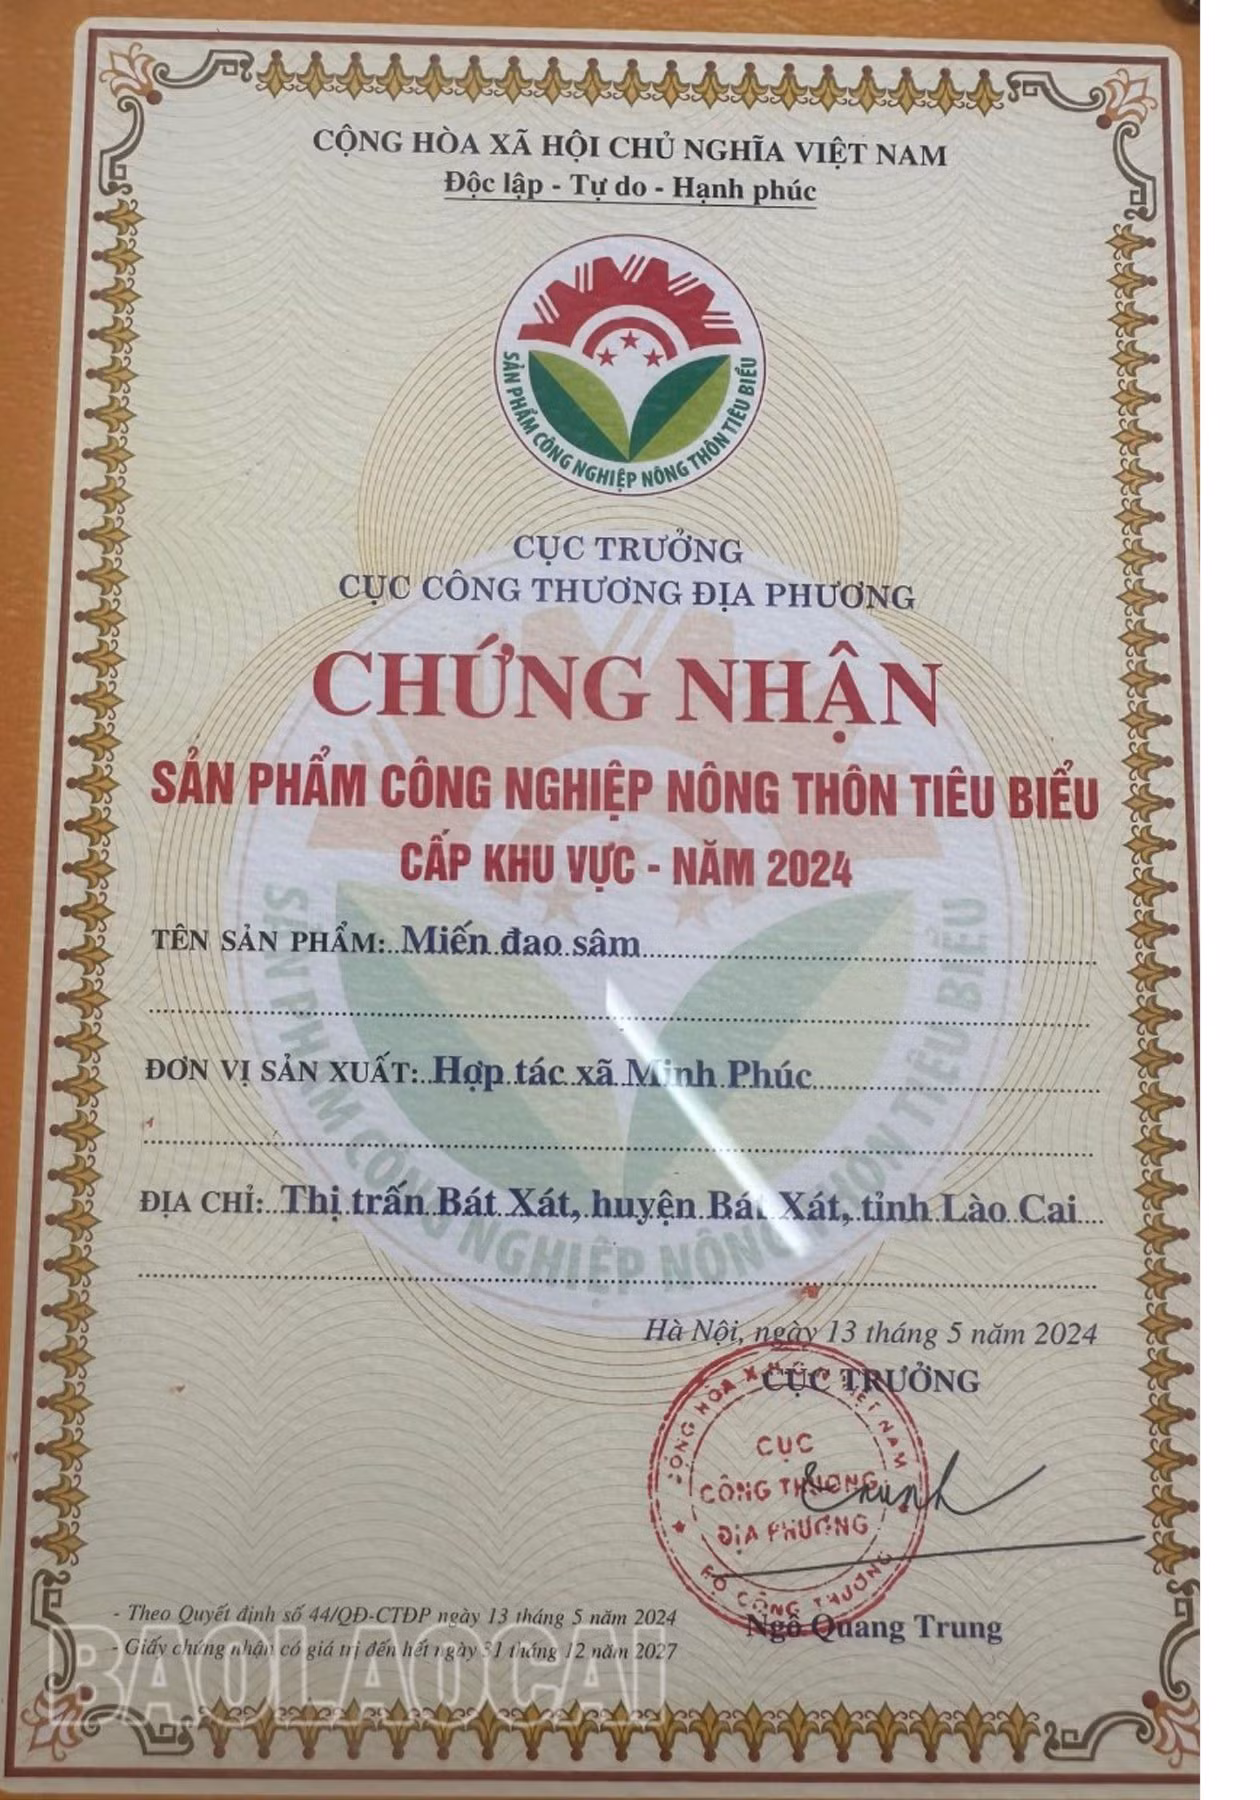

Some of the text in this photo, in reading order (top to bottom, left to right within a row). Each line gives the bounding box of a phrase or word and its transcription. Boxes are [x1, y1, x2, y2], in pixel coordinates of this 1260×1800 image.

[313, 124, 946, 169] CỘNG HÒA XÃ HỘI CHỦ NGHĨA VIỆT NAM
[444, 170, 817, 205] Độc lập Tự do Hạnh phúc
[502, 351, 757, 493] SẢN PHẨM CÔNG NGHIỆP NÔNG THÔN TIÊU BIỂU
[513, 528, 743, 567] CỤC TRƯỞNG
[339, 569, 915, 612] CỤC CÔNG THƯƠNG ĐỊA PHƯƠNG
[312, 633, 943, 742] CHỨNG NHẬN
[151, 745, 1098, 821] SẢN PHẨM CÔNG NGHIỆP NÔNG THÔN TIÊU BIỂU
[401, 828, 853, 893] CẤP KHU VỰC NĂM 2024
[152, 924, 208, 952] TÊN
[222, 923, 278, 953] SẢN
[402, 920, 489, 956] Miến
[500, 927, 563, 956] đao
[572, 929, 641, 957] sâm
[145, 1056, 208, 1081] ĐƠN
[221, 1059, 250, 1087] VỊ
[261, 1053, 318, 1083] SẢN
[434, 1055, 504, 1092] Hợp
[516, 1057, 565, 1087] tác
[577, 1059, 615, 1087] xã
[626, 1058, 715, 1088] Minh
[728, 1060, 812, 1089] Phúc
[140, 1190, 191, 1218] ĐỊA
[281, 1184, 341, 1222] Thị
[352, 1180, 424, 1216] trấn
[437, 1187, 501, 1217] Bát
[509, 1187, 584, 1223] Xát,
[592, 1189, 696, 1226] huyện
[861, 1191, 929, 1223] tỉnh
[944, 1194, 1006, 1223] Lào
[1019, 1195, 1076, 1223] Cai
[644, 1318, 1098, 1350] Hà Nội, ngày 13 tháng 5 năm 2024
[761, 1366, 830, 1398] CỤC
[841, 1361, 981, 1394] TRƯỞNG
[757, 1432, 814, 1462] CỤC
[700, 1473, 771, 1504] CÔNG
[127, 1603, 678, 1629] Theo Quyết định số 44/QĐ-CTĐP ngày 13 tháng 5 năm 2024
[747, 1613, 1002, 1645] Ngô Quang Trung
[125, 1636, 168, 1660] Giấy
[172, 1637, 225, 1660] chứng
[230, 1639, 275, 1660] nhận
[280, 1639, 303, 1657] có
[306, 1639, 340, 1661] giá
[344, 1641, 360, 1660] trị
[365, 1638, 398, 1658] đến
[402, 1639, 429, 1659] hết
[434, 1643, 478, 1662] ngày
[509, 1641, 558, 1663] tháng
[566, 1642, 585, 1660] 12
[591, 1643, 628, 1660] năm
[634, 1642, 678, 1661] 2027
